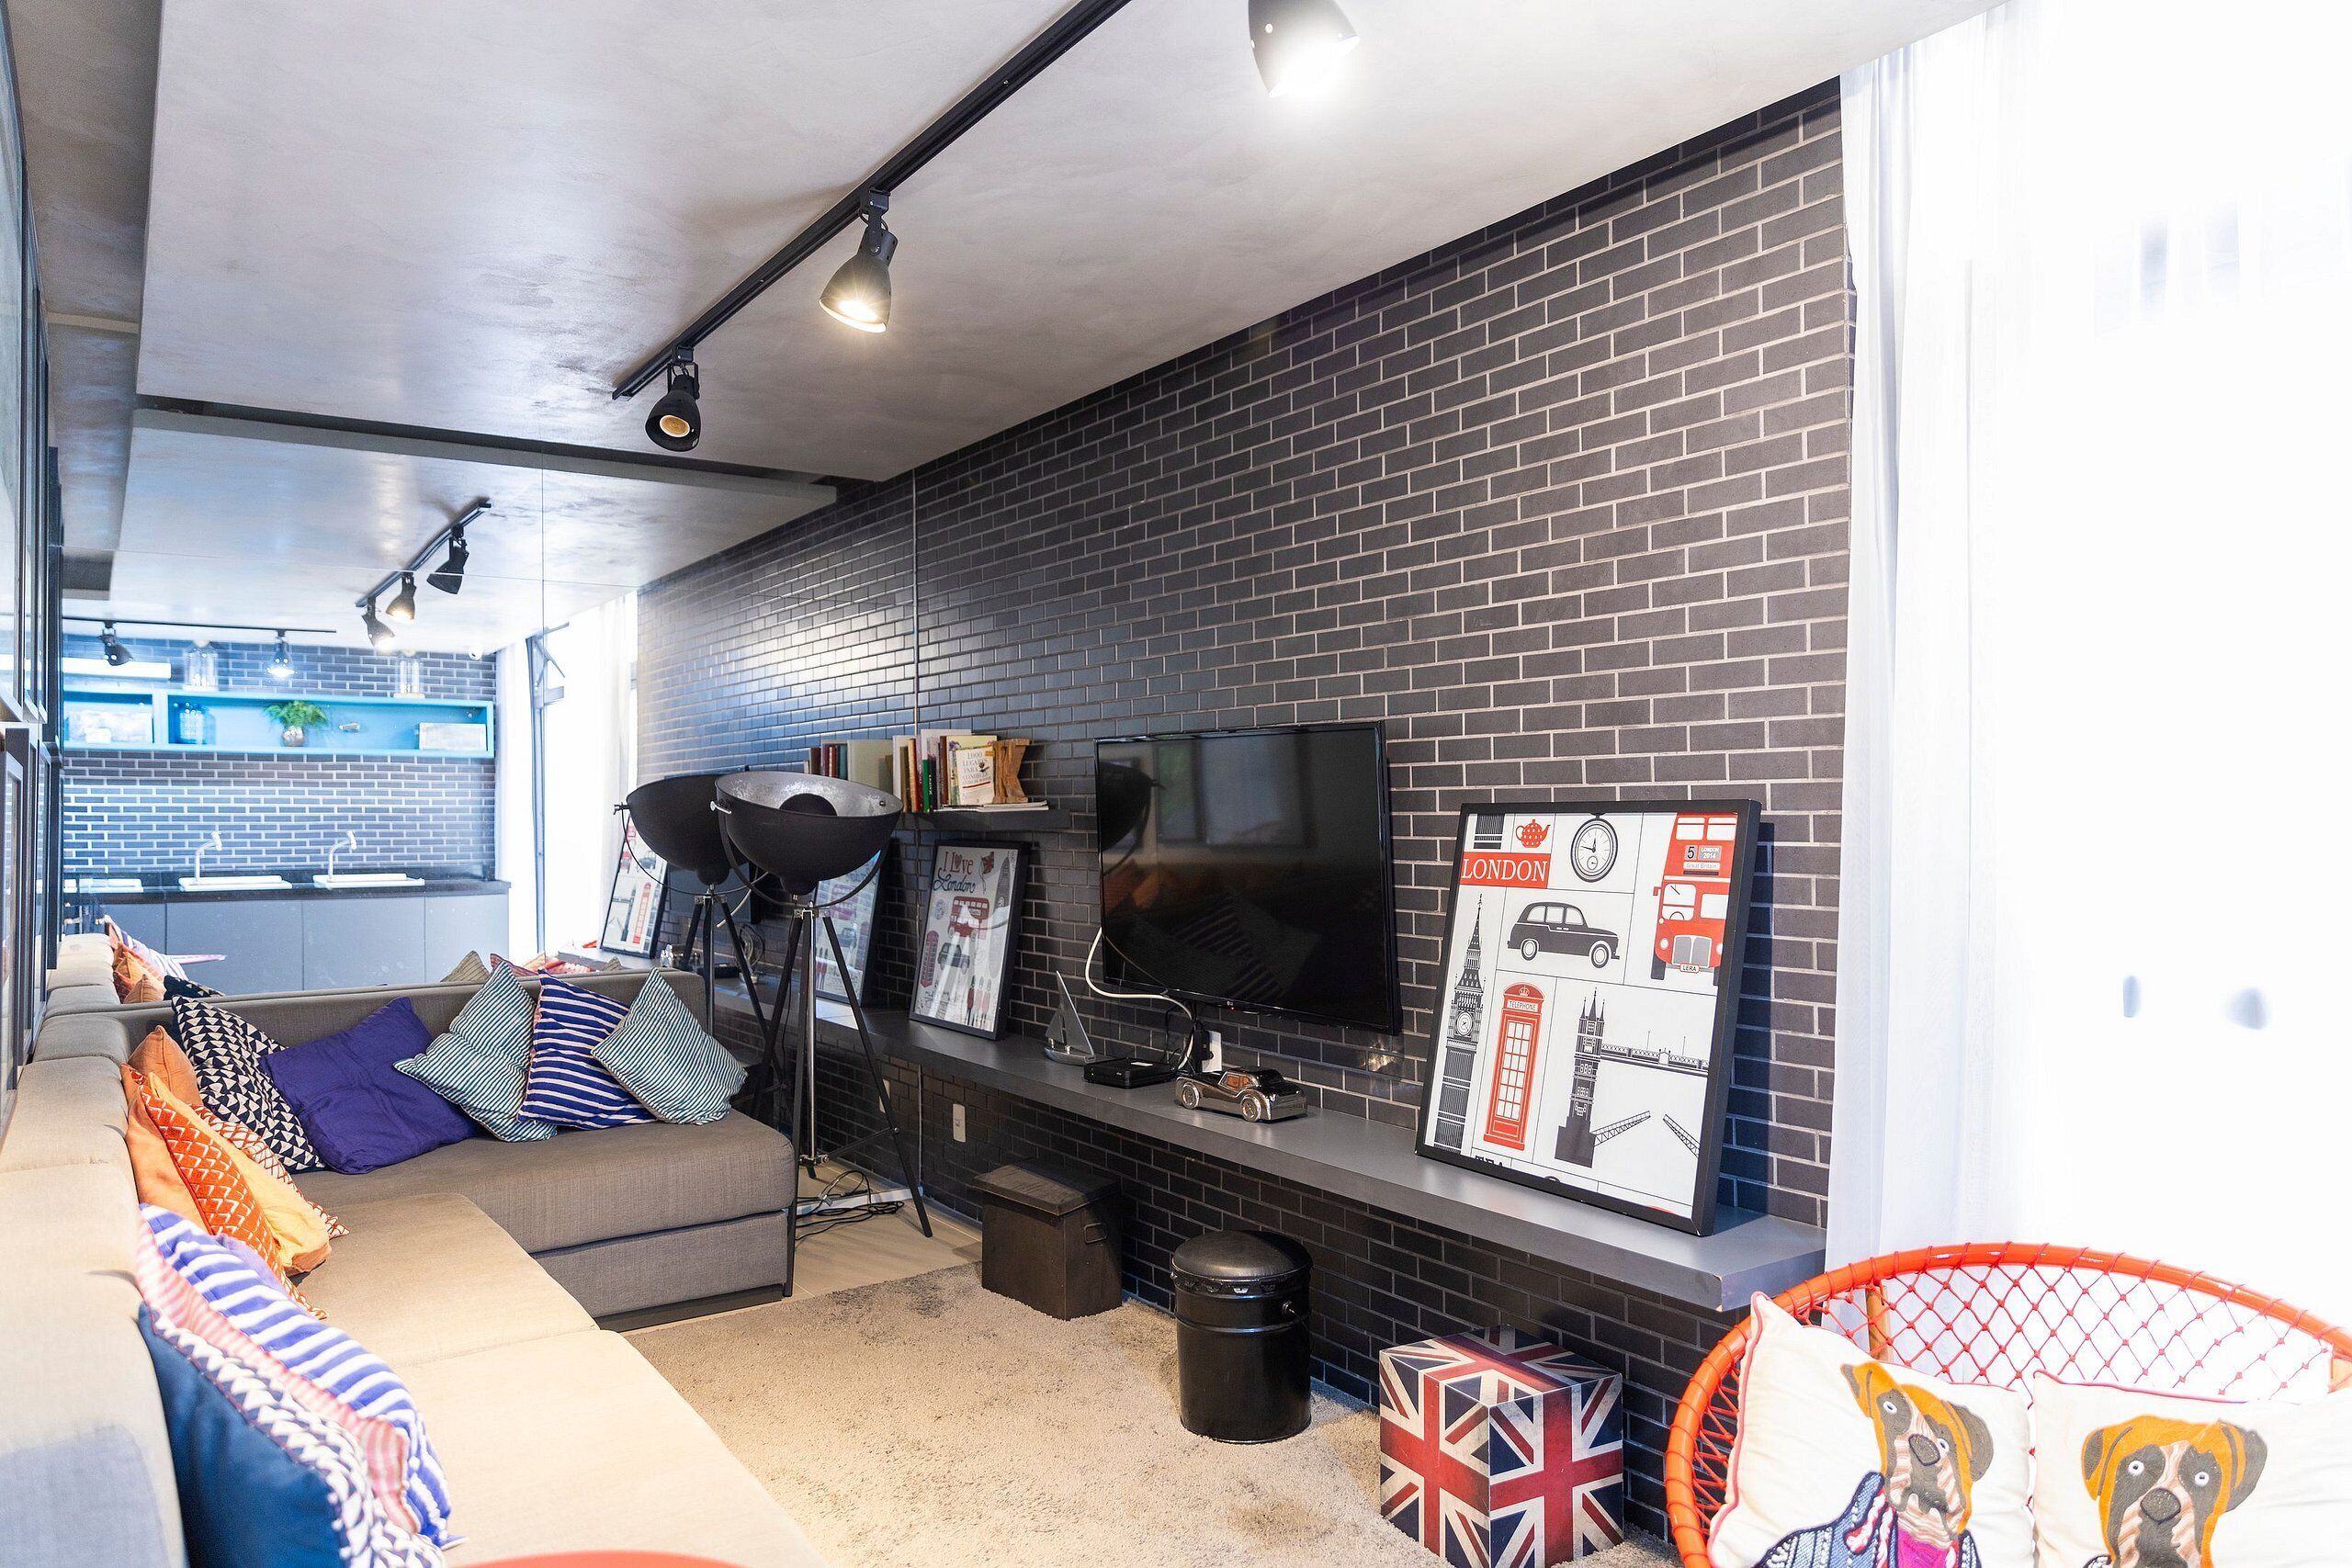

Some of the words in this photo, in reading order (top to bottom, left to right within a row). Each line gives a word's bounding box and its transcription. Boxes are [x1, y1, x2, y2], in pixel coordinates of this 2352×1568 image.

[942, 851, 949, 872] I
[1687, 846, 1695, 859] 5
[933, 866, 976, 894] London
[1461, 858, 1548, 882] LONDON
[1510, 1000, 1536, 1011] TELEPHONE
